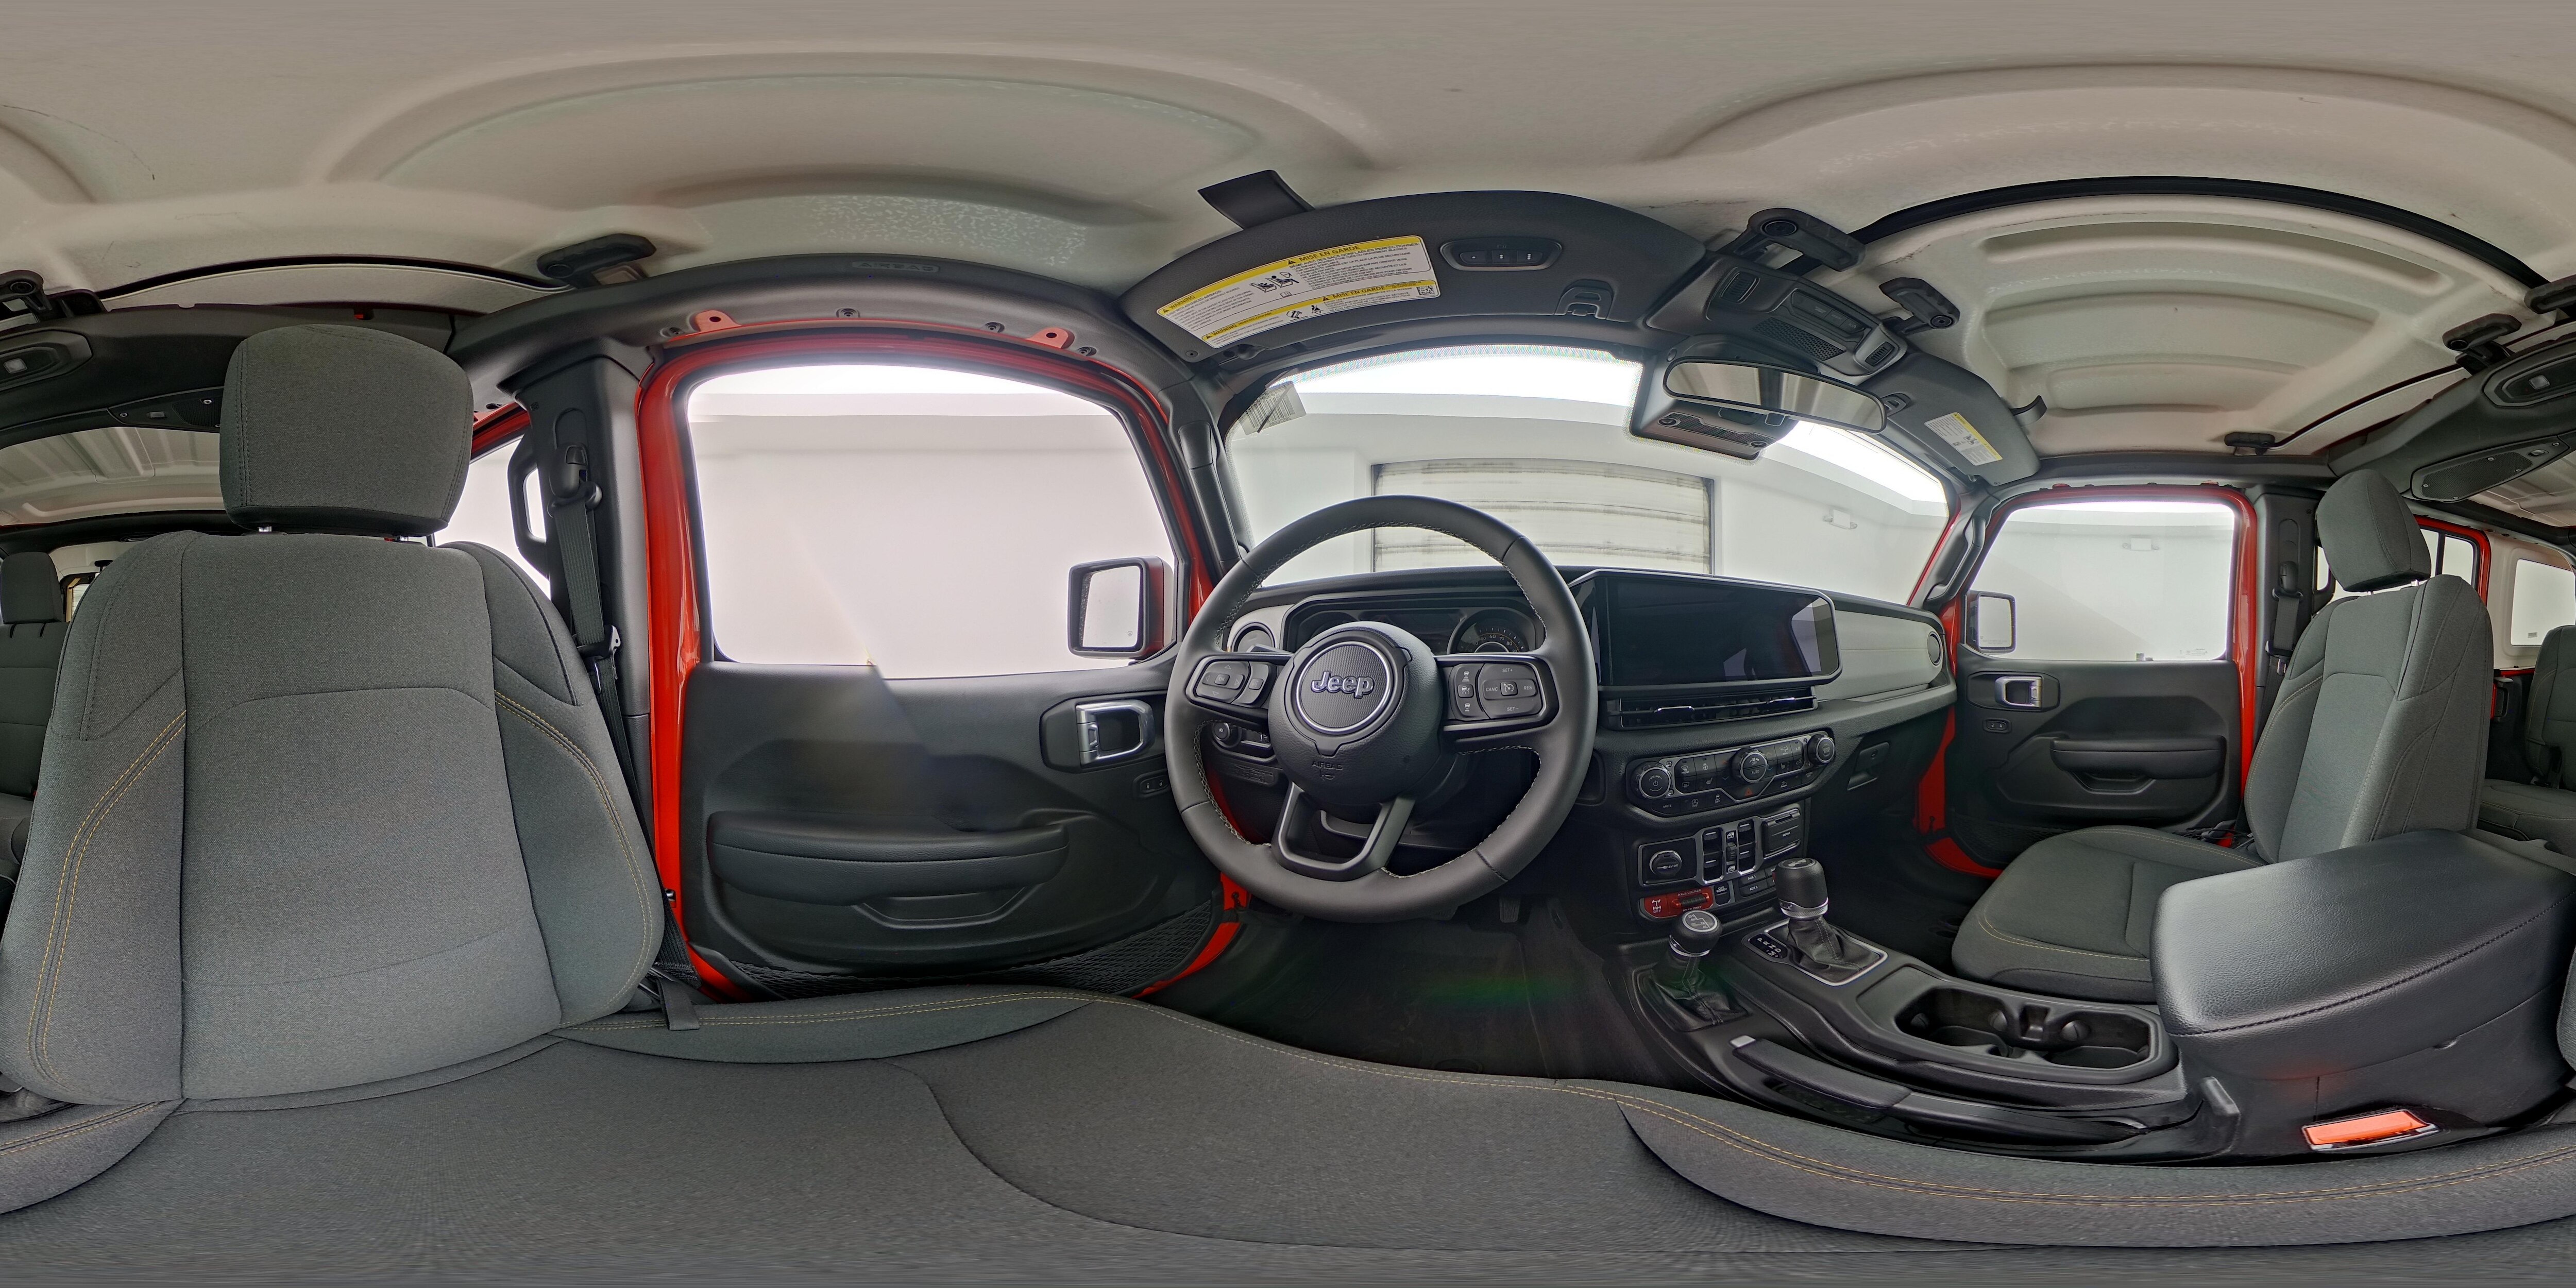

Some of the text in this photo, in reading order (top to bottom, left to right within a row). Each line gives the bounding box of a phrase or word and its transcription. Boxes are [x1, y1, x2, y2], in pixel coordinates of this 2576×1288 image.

[1332, 245, 1360, 254] GARDE
[858, 263, 934, 272] AIRBAG
[1168, 295, 1196, 309] WARNING
[1212, 324, 1238, 336] WARNING
[1311, 671, 1375, 699] Jeep
[1312, 761, 1343, 771] AIRBAG
